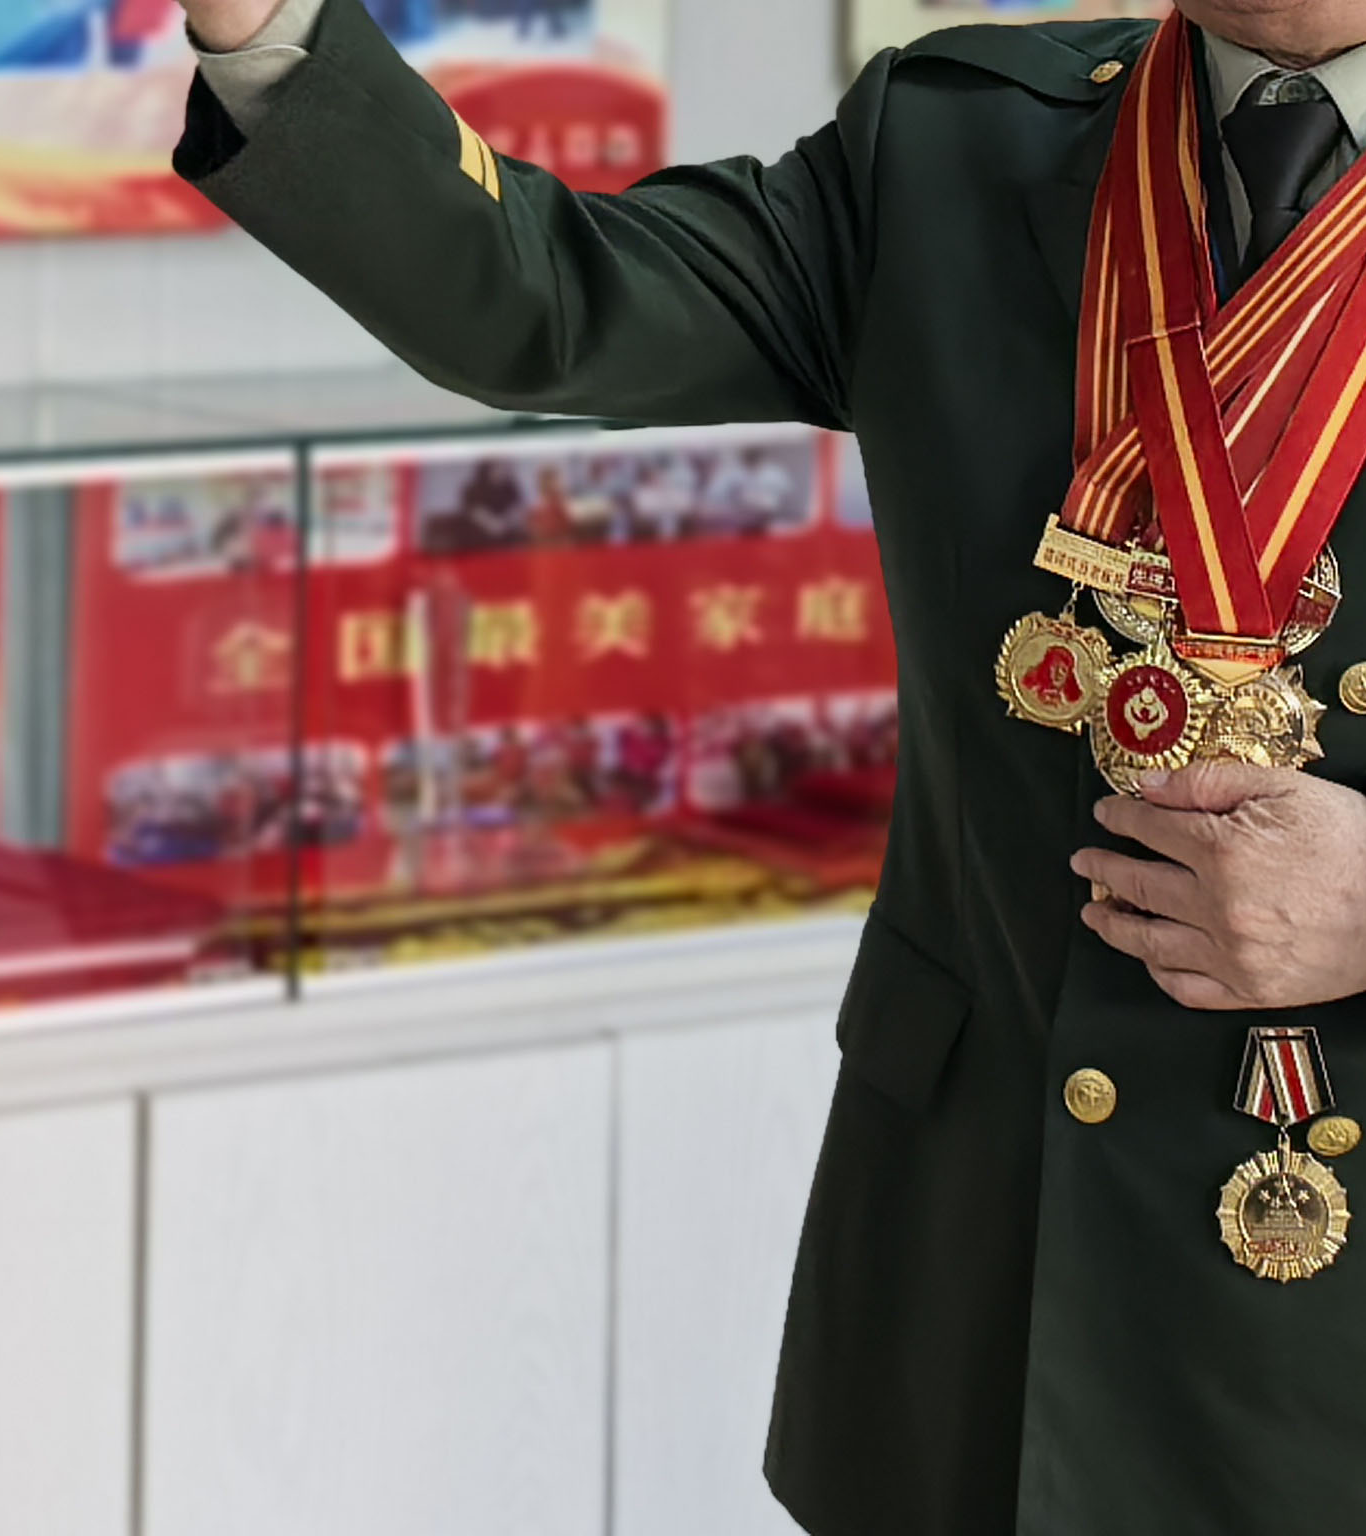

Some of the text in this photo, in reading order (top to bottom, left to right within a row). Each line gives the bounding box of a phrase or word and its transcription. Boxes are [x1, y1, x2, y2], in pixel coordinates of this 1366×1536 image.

[206, 574, 872, 696] 全国最美家庭
